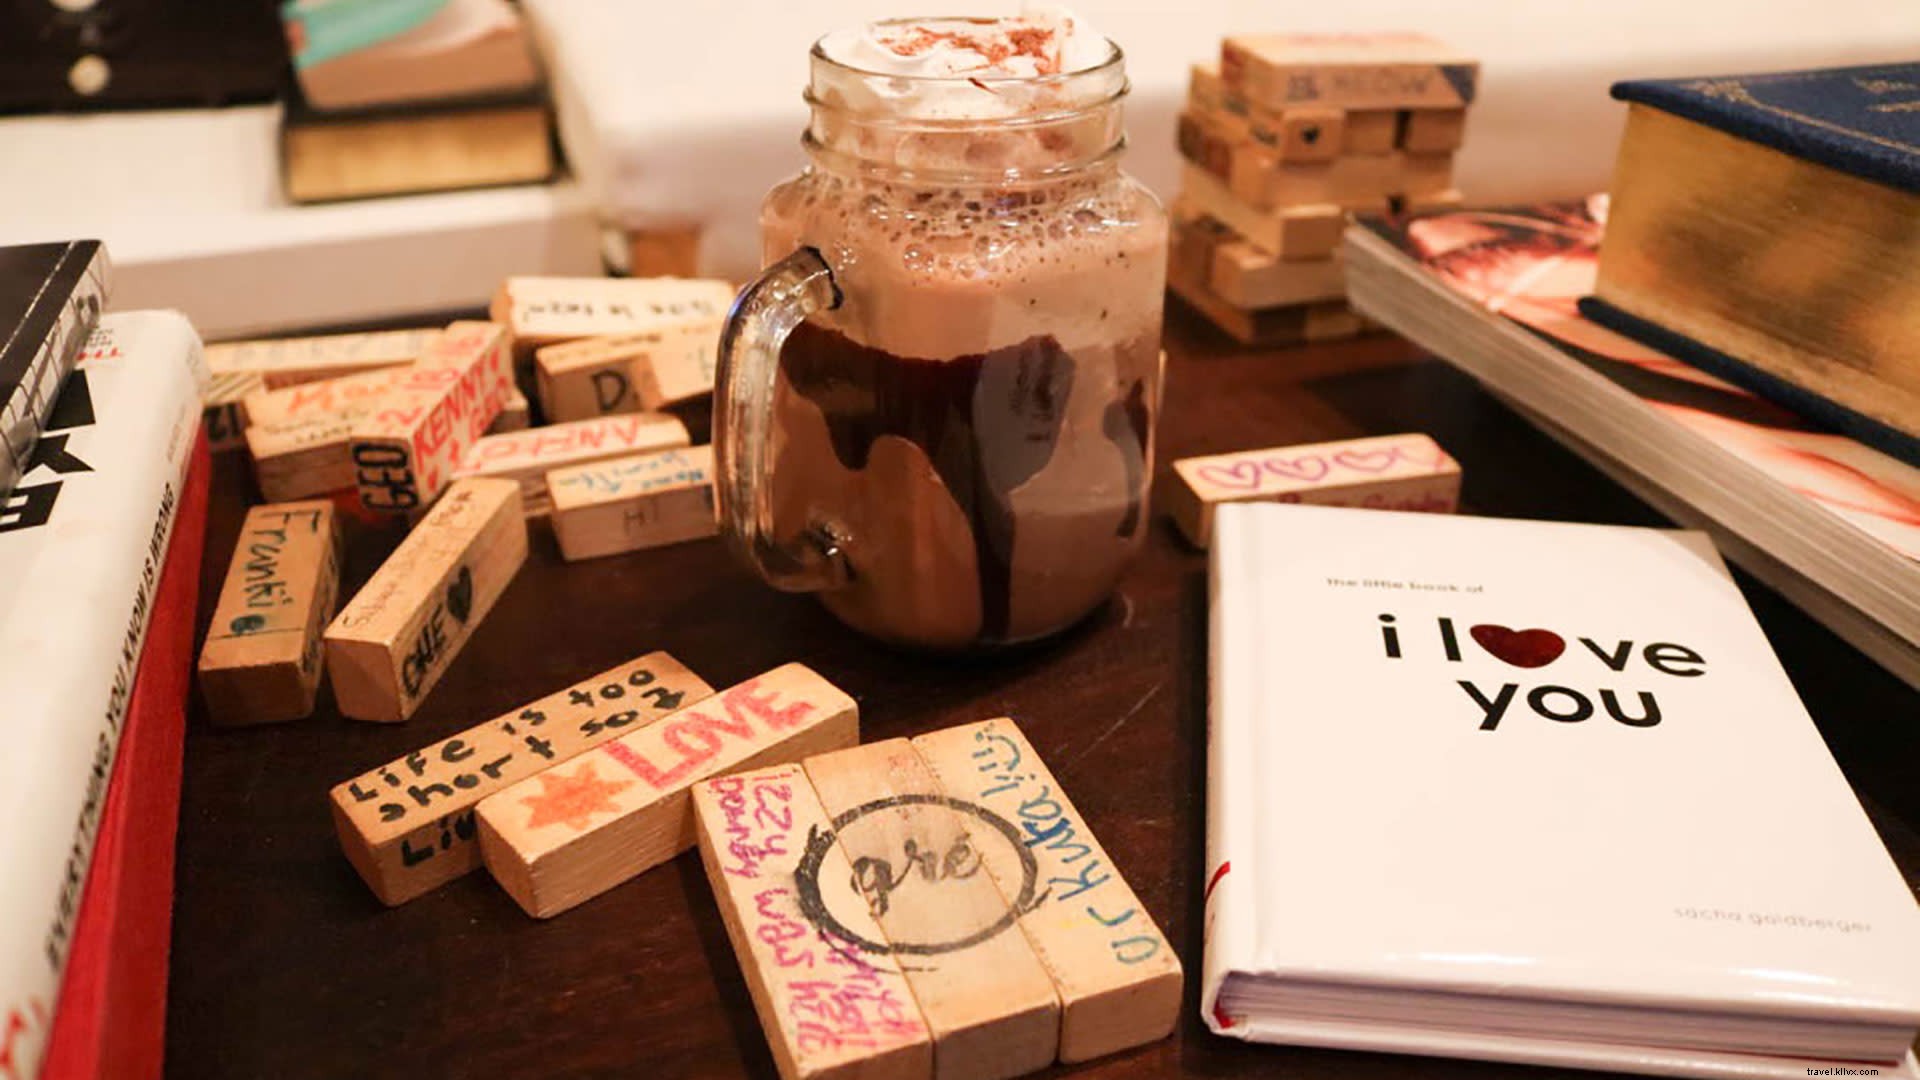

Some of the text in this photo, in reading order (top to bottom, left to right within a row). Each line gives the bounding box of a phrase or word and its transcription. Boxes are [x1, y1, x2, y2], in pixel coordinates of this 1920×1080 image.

[121, 581, 148, 660] KNOW
[150, 483, 175, 567] WRONG
[1327, 577, 1357, 587] the
[1363, 578, 1403, 590] little
[1378, 613, 1402, 659] i
[502, 707, 547, 736] is
[569, 668, 656, 707] too
[601, 679, 813, 791] LOVE
[1456, 680, 1663, 731] you
[379, 735, 558, 823] short
